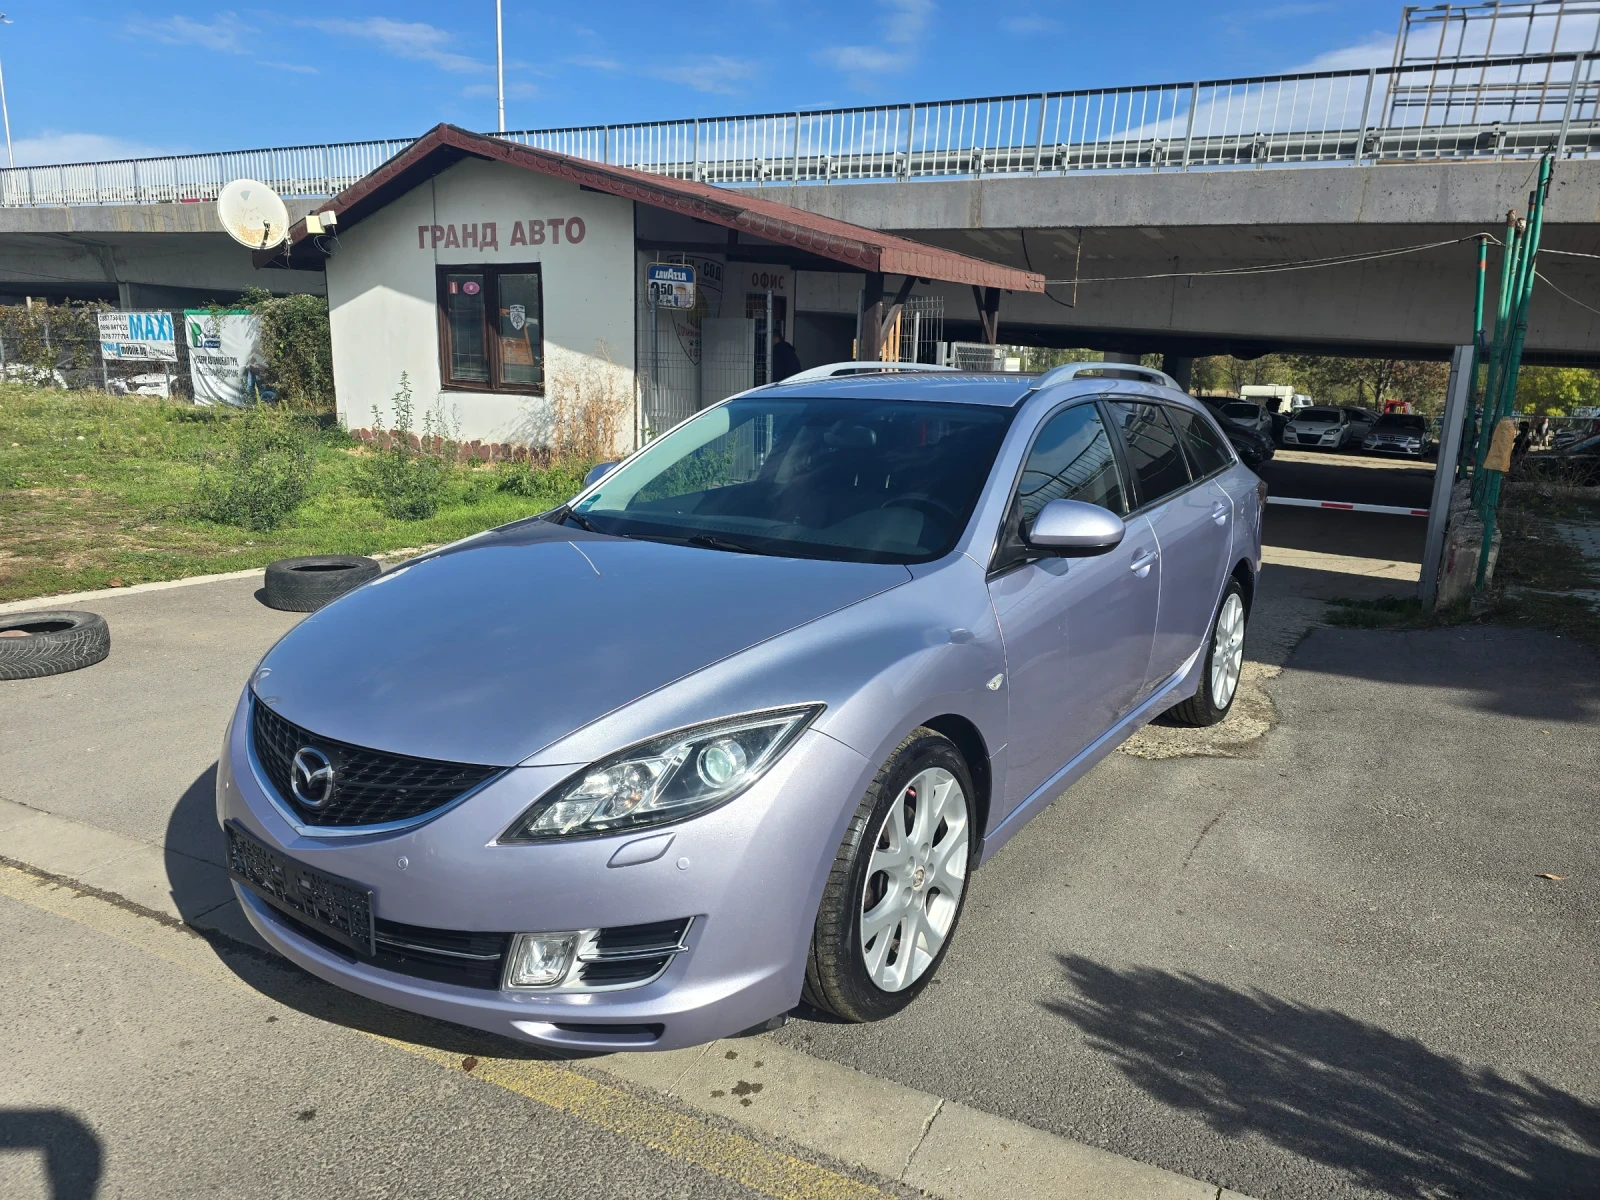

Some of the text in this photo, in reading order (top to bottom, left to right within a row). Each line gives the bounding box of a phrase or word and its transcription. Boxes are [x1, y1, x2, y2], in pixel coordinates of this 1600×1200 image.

[418, 216, 586, 252] ГРАНД АВТО
[655, 268, 687, 281] LAVAZZA
[751, 272, 785, 290] ОФИС
[128, 313, 174, 341] MAXI
